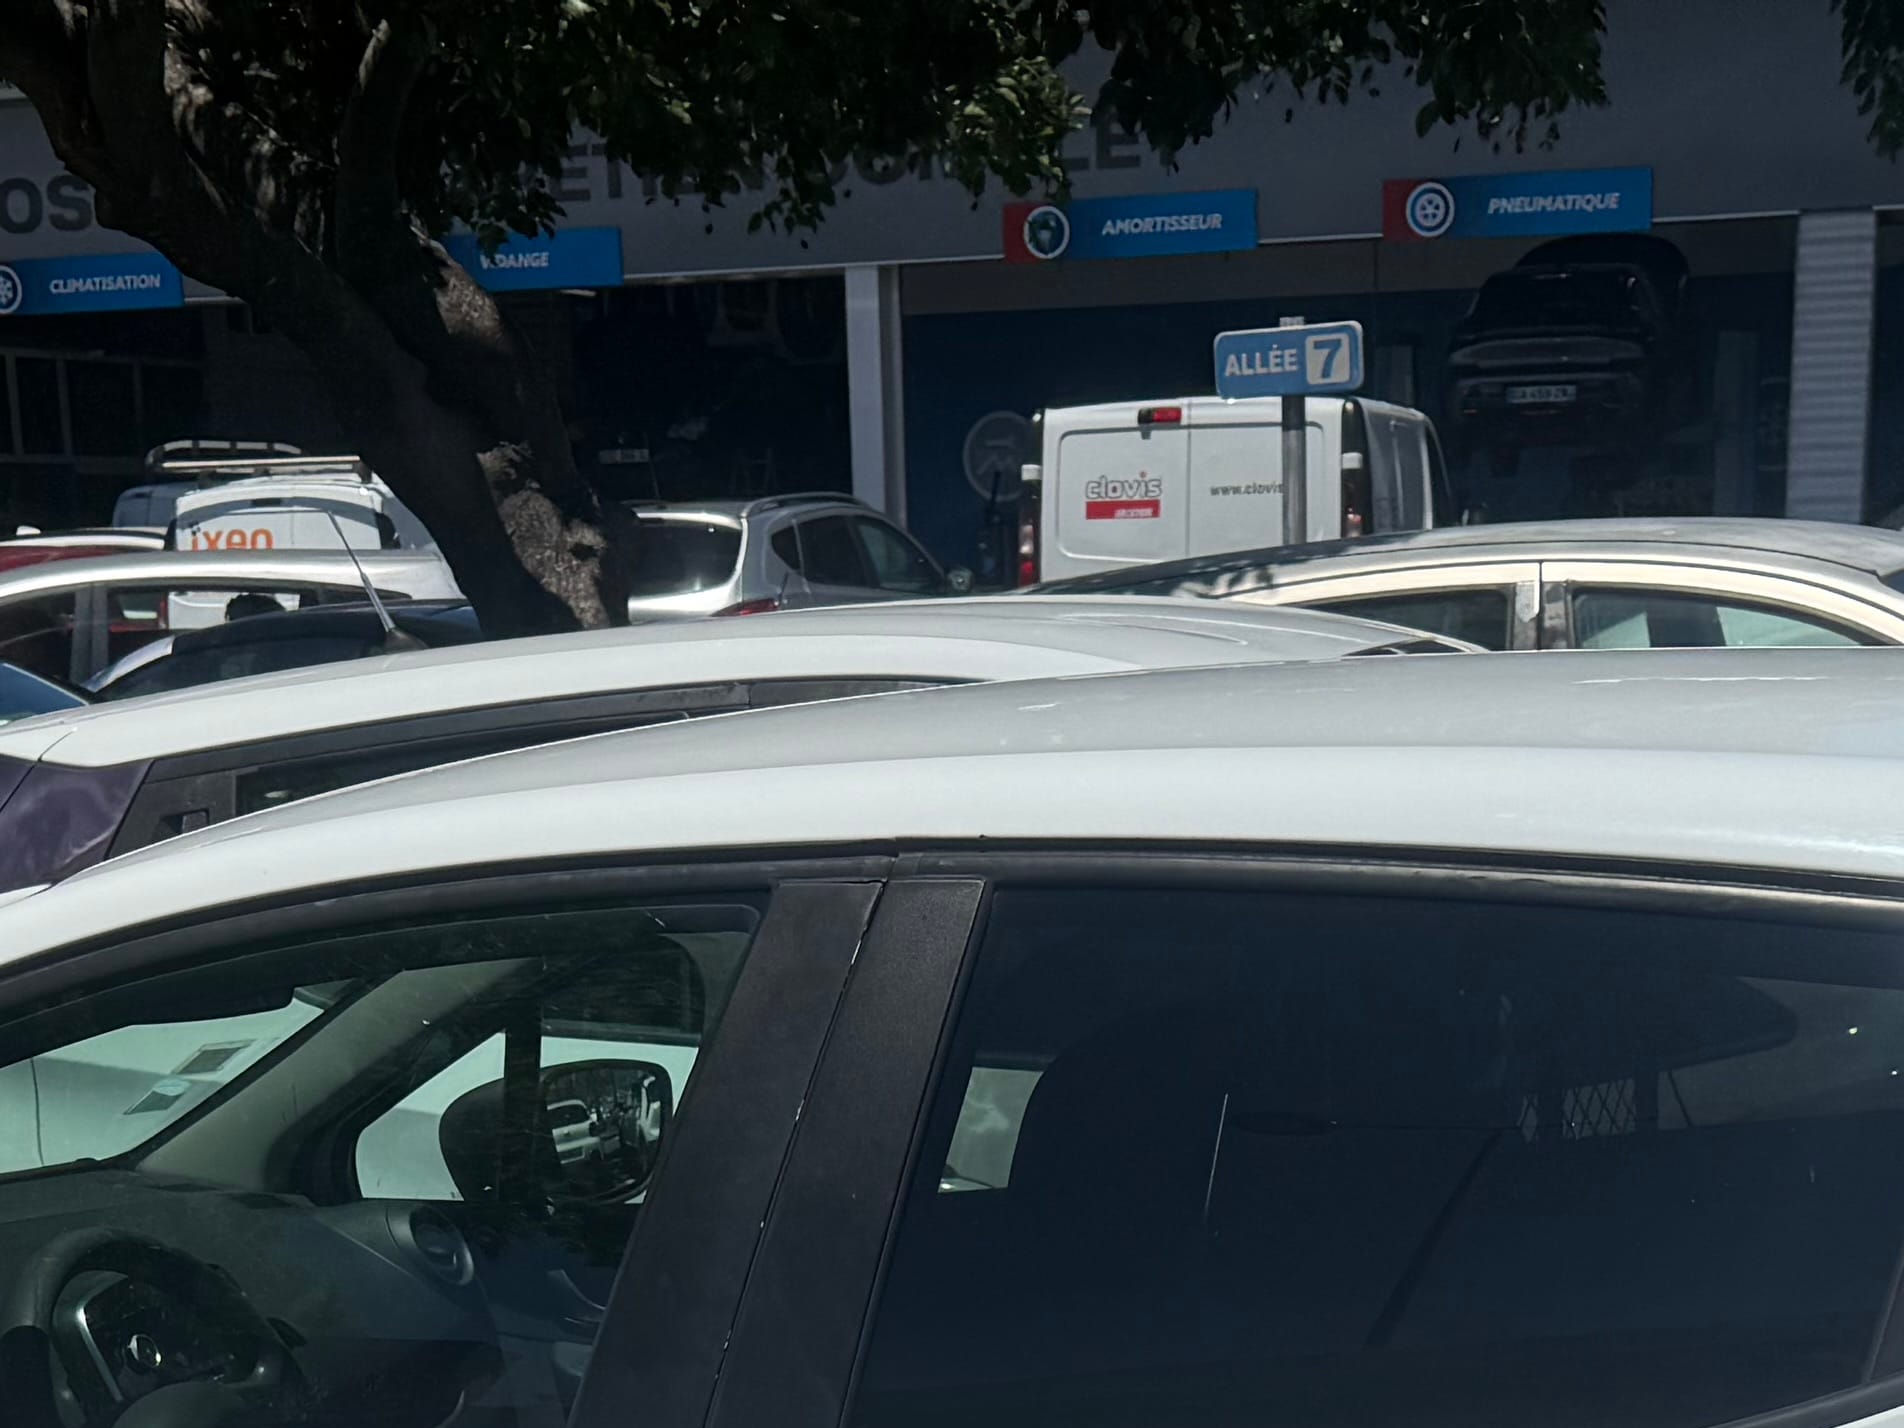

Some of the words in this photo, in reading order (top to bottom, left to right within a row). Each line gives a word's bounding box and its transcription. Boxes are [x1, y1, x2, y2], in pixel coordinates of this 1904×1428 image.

[1487, 192, 1621, 214] PNEUMATIQUE
[1102, 213, 1223, 236] AMORTISSEUR
[49, 274, 161, 294] CLIMATISATION
[1225, 344, 1299, 376] ALLÉE
[1313, 338, 1342, 379] 7
[1086, 470, 1162, 499] clovis
